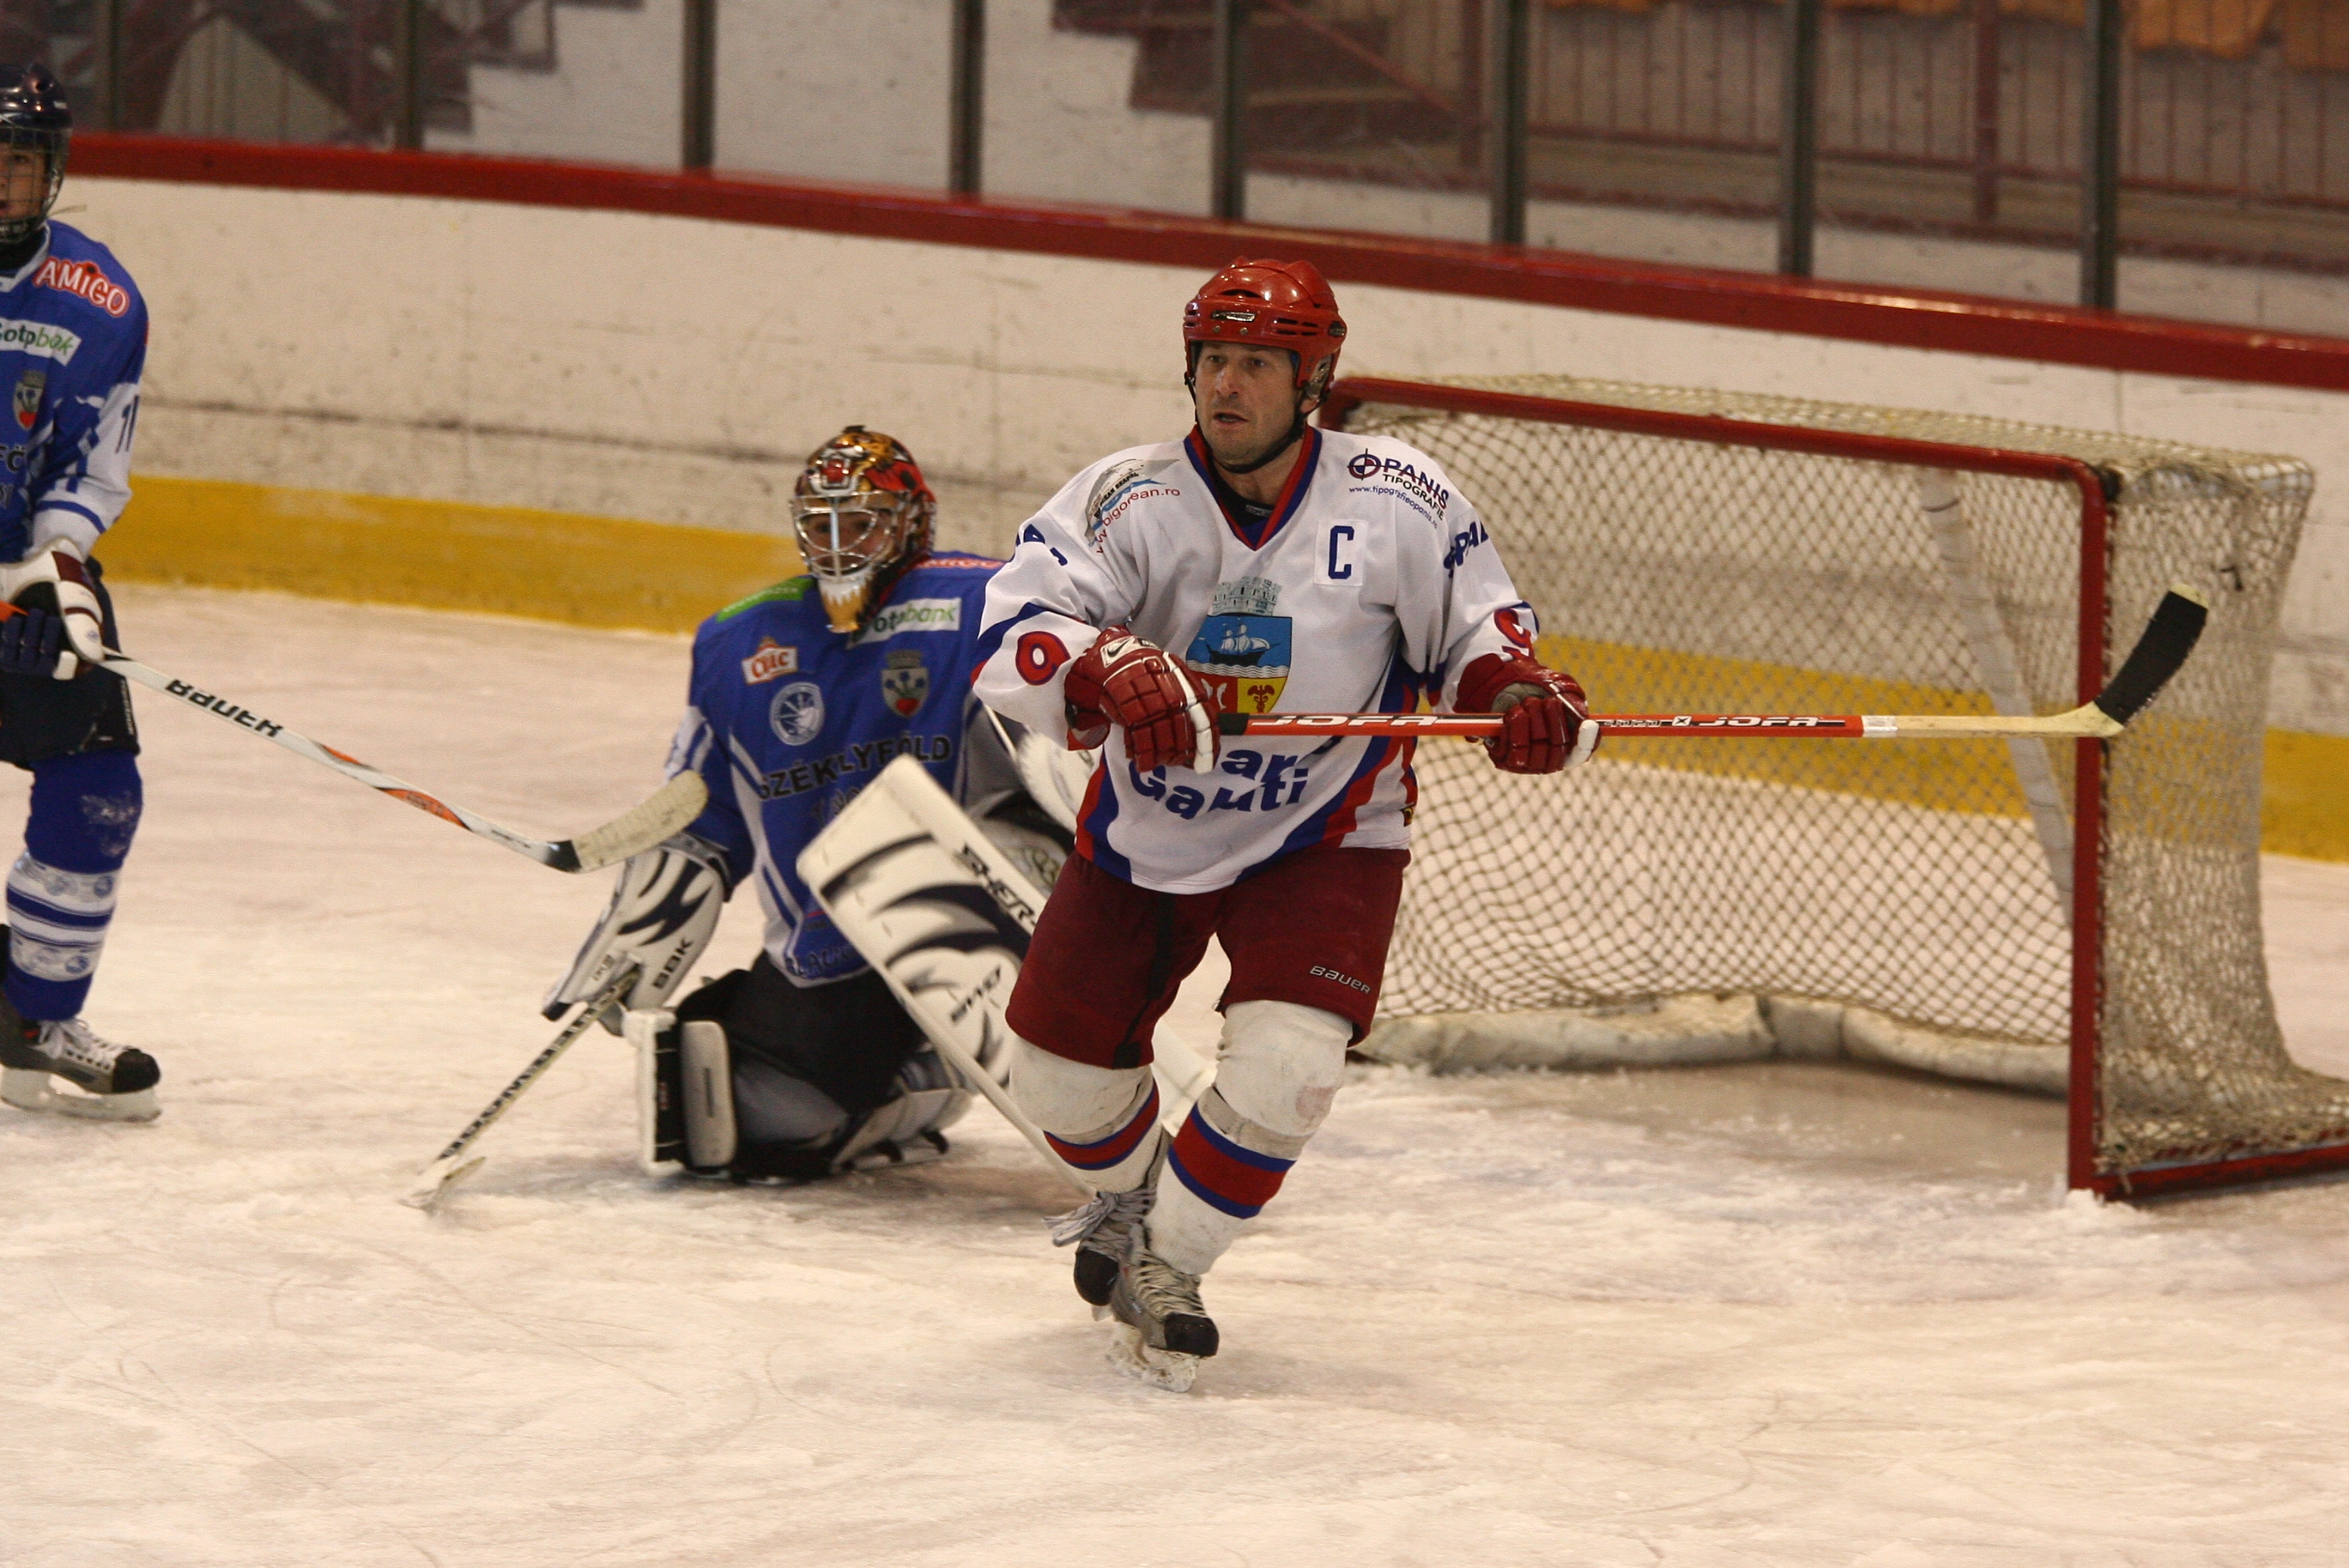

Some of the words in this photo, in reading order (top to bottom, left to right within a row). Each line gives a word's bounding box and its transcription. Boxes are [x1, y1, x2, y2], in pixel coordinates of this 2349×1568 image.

[1382, 473, 1444, 521] TIPOGRAFIE
[1328, 525, 1355, 580] C
[1251, 715, 1439, 726] JOFA
[1699, 716, 1819, 726] JOFA
